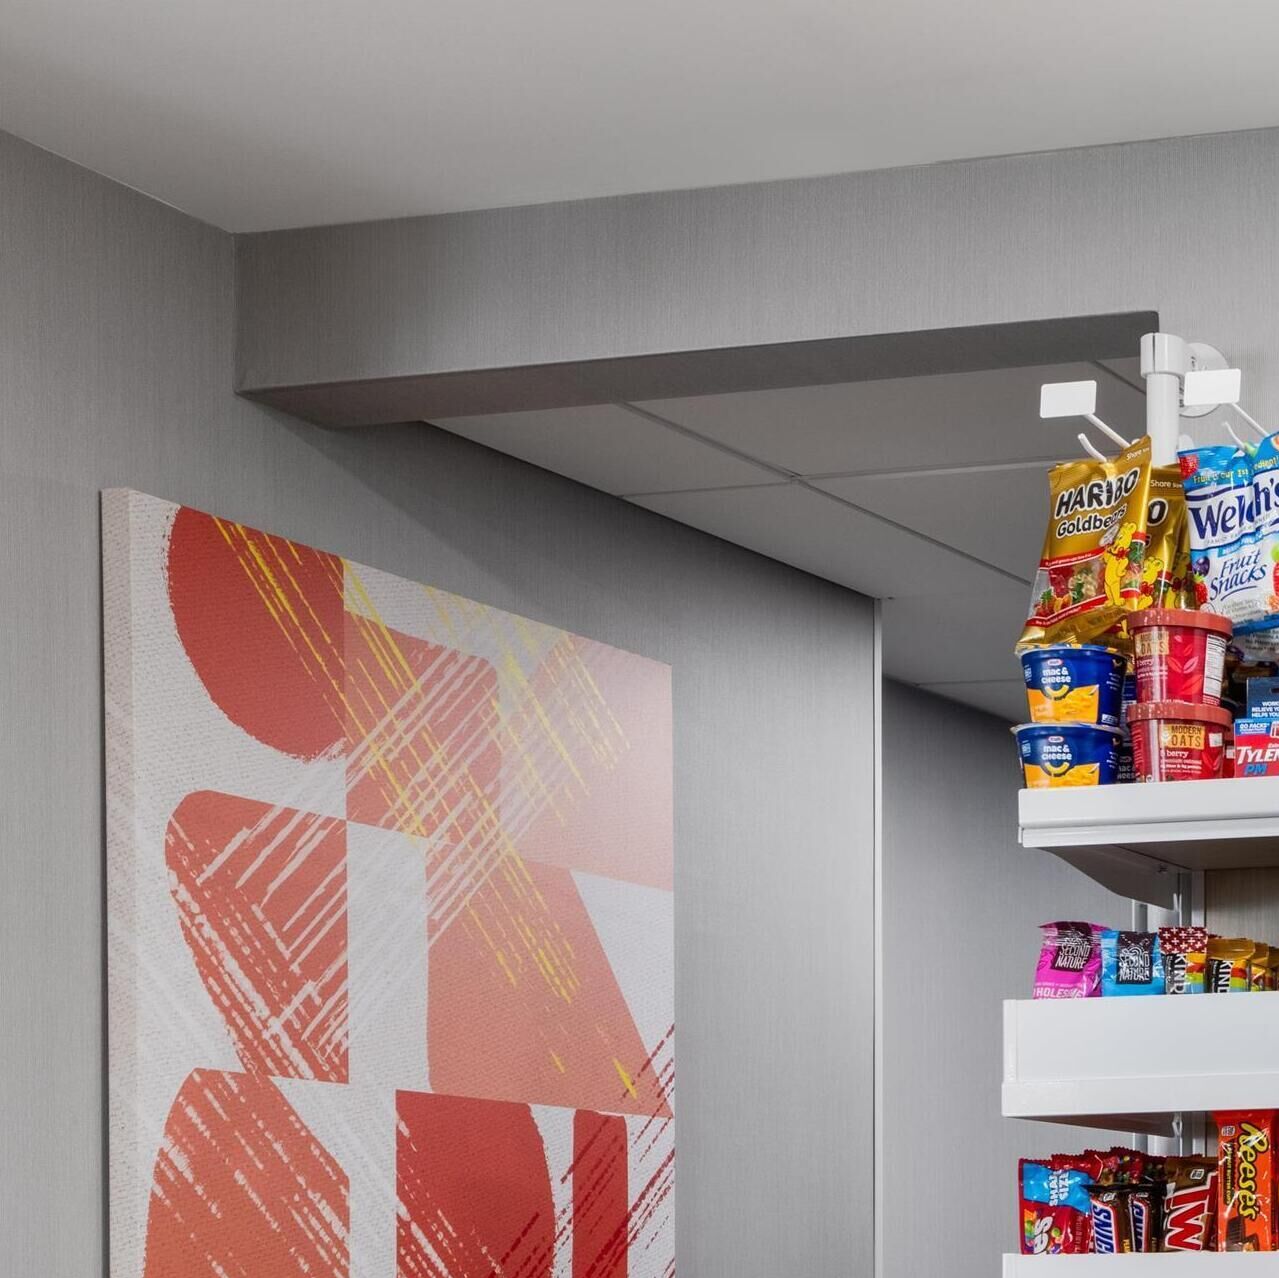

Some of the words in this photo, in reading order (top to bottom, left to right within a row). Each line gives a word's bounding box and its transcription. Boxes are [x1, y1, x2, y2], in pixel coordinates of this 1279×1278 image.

[1055, 467, 1141, 519] HARIBO
[1056, 505, 1127, 538] Goldbears
[1221, 550, 1261, 578] Fruit
[1210, 564, 1267, 601] Snacks
[1171, 725, 1201, 735] MODERN
[1171, 734, 1201, 747] OATS
[1165, 749, 1189, 759] berry
[1058, 942, 1091, 957] SECOND
[1238, 1121, 1270, 1221] Reese's
